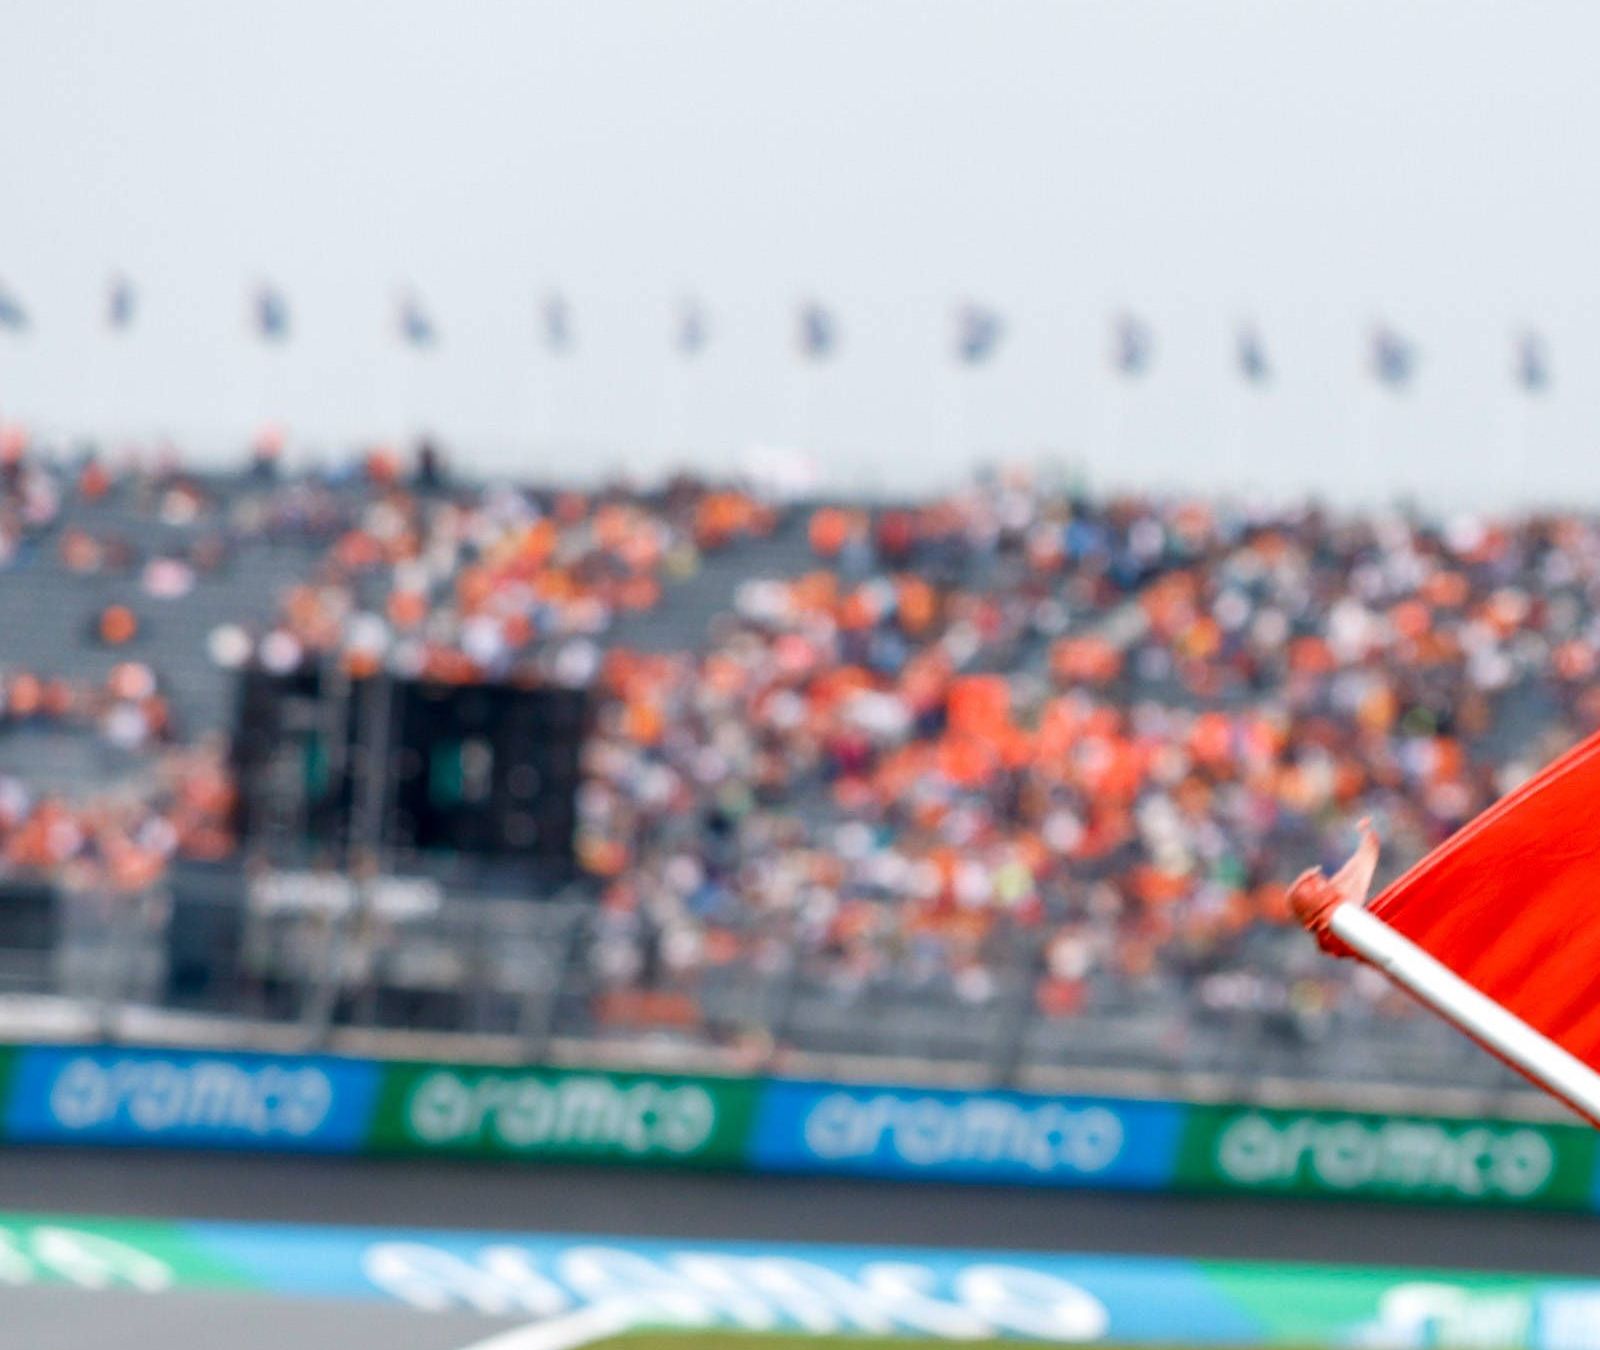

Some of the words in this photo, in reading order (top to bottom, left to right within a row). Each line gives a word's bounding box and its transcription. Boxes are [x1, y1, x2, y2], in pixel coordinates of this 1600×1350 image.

[50, 1058, 332, 1136] aramco
[410, 1071, 716, 1155] aramco
[804, 1089, 1124, 1172] aramco
[1217, 1112, 1554, 1196] aramco
